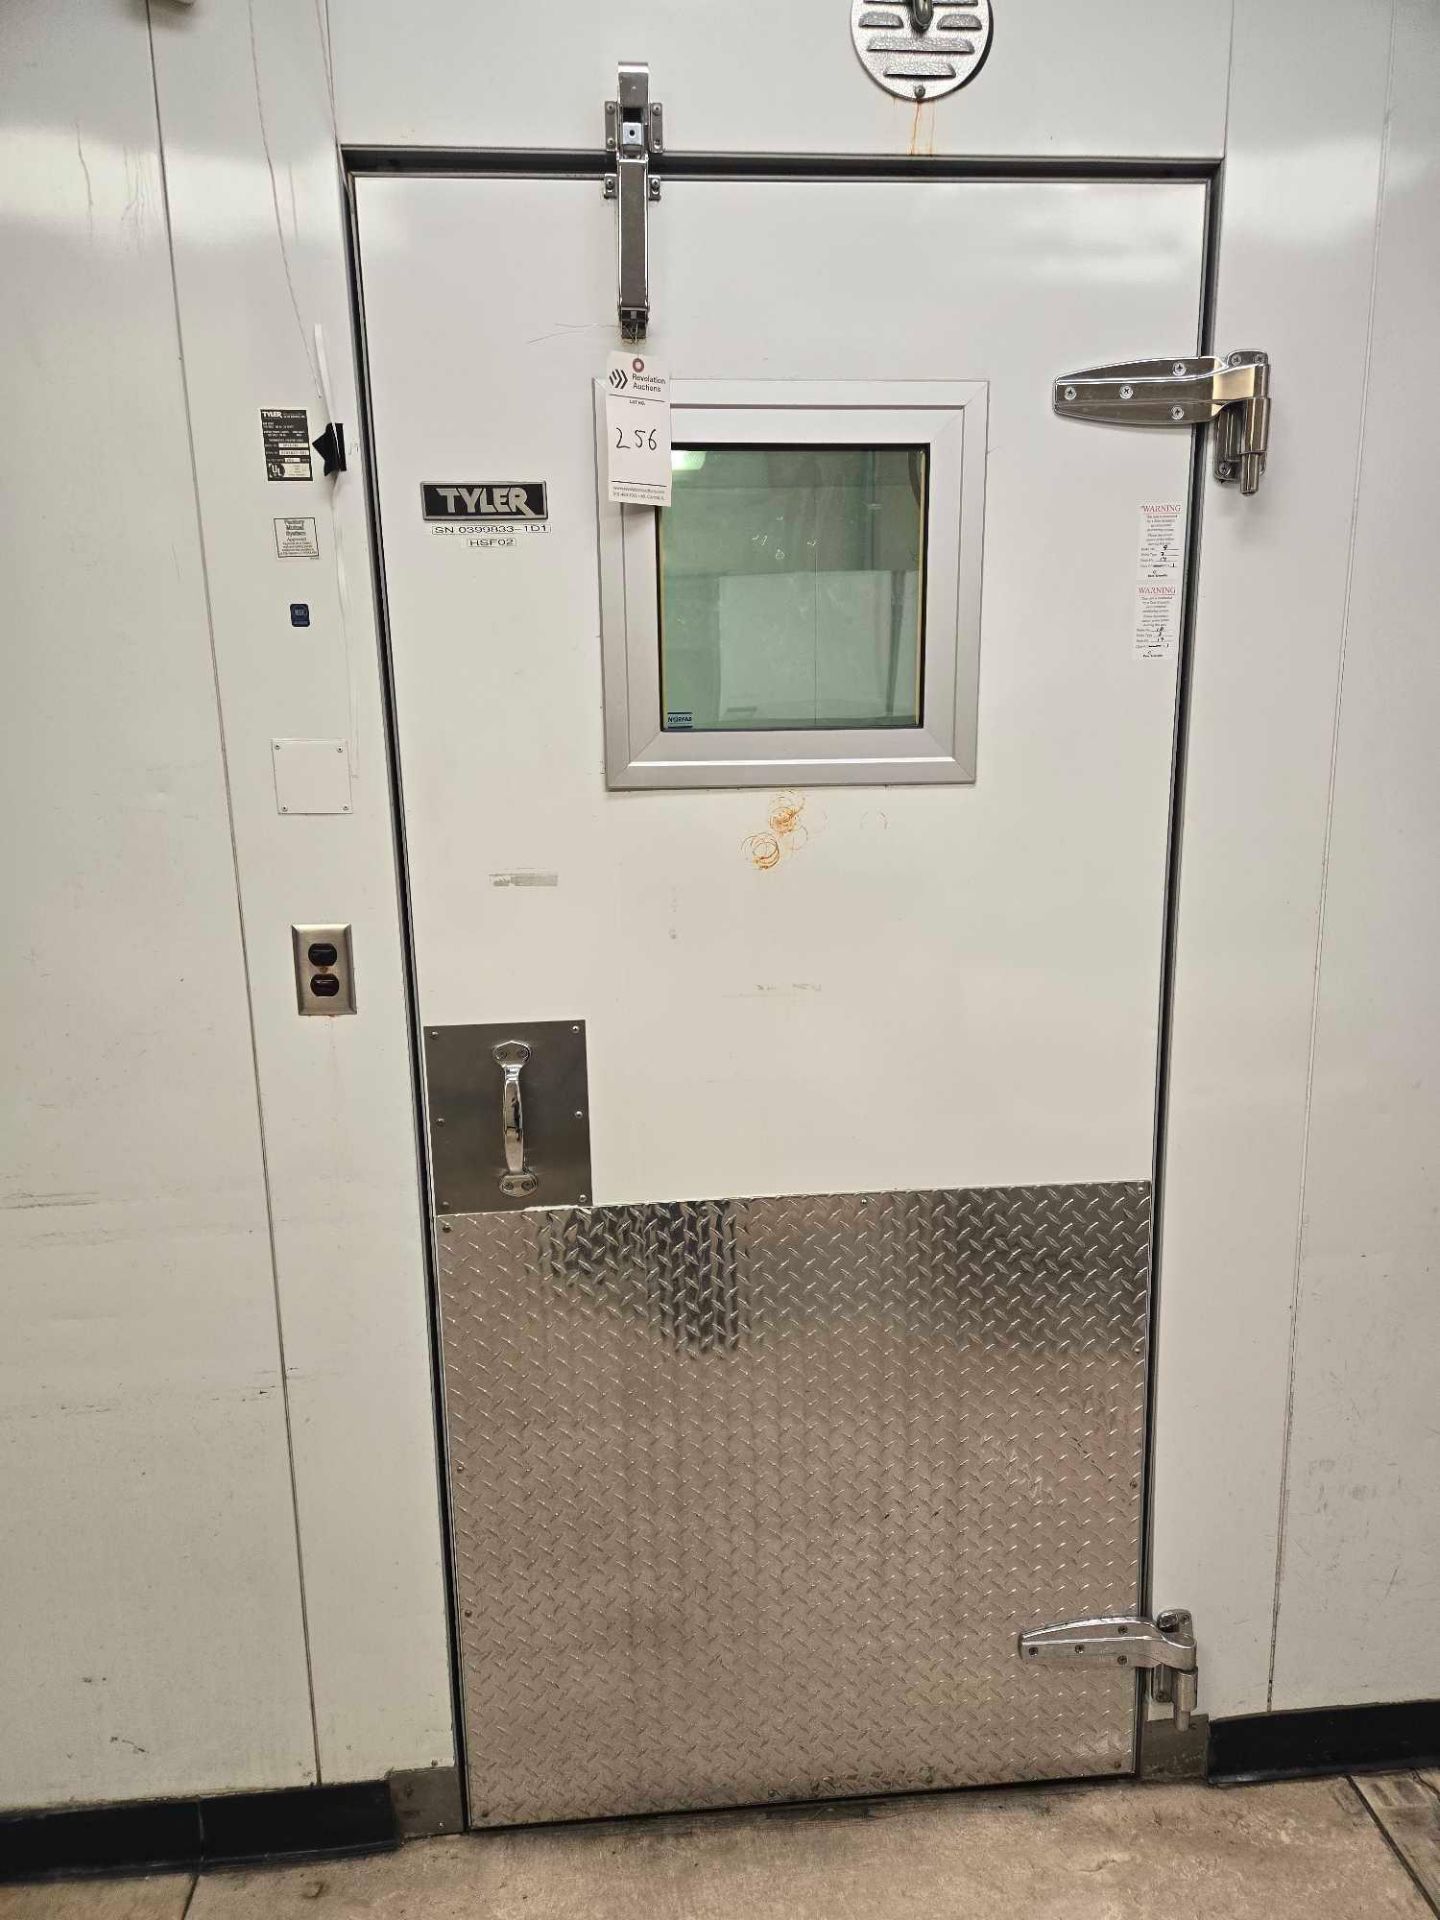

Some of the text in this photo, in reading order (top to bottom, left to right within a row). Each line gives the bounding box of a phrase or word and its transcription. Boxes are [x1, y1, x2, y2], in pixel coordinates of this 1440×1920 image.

[632, 382, 661, 392] Auctions
[262, 411, 283, 419] TYLER
[616, 427, 657, 451] 256
[436, 487, 537, 519] TYLER
[1141, 504, 1181, 512] WARNING
[434, 526, 454, 534] SN
[469, 538, 514, 546] HSF02
